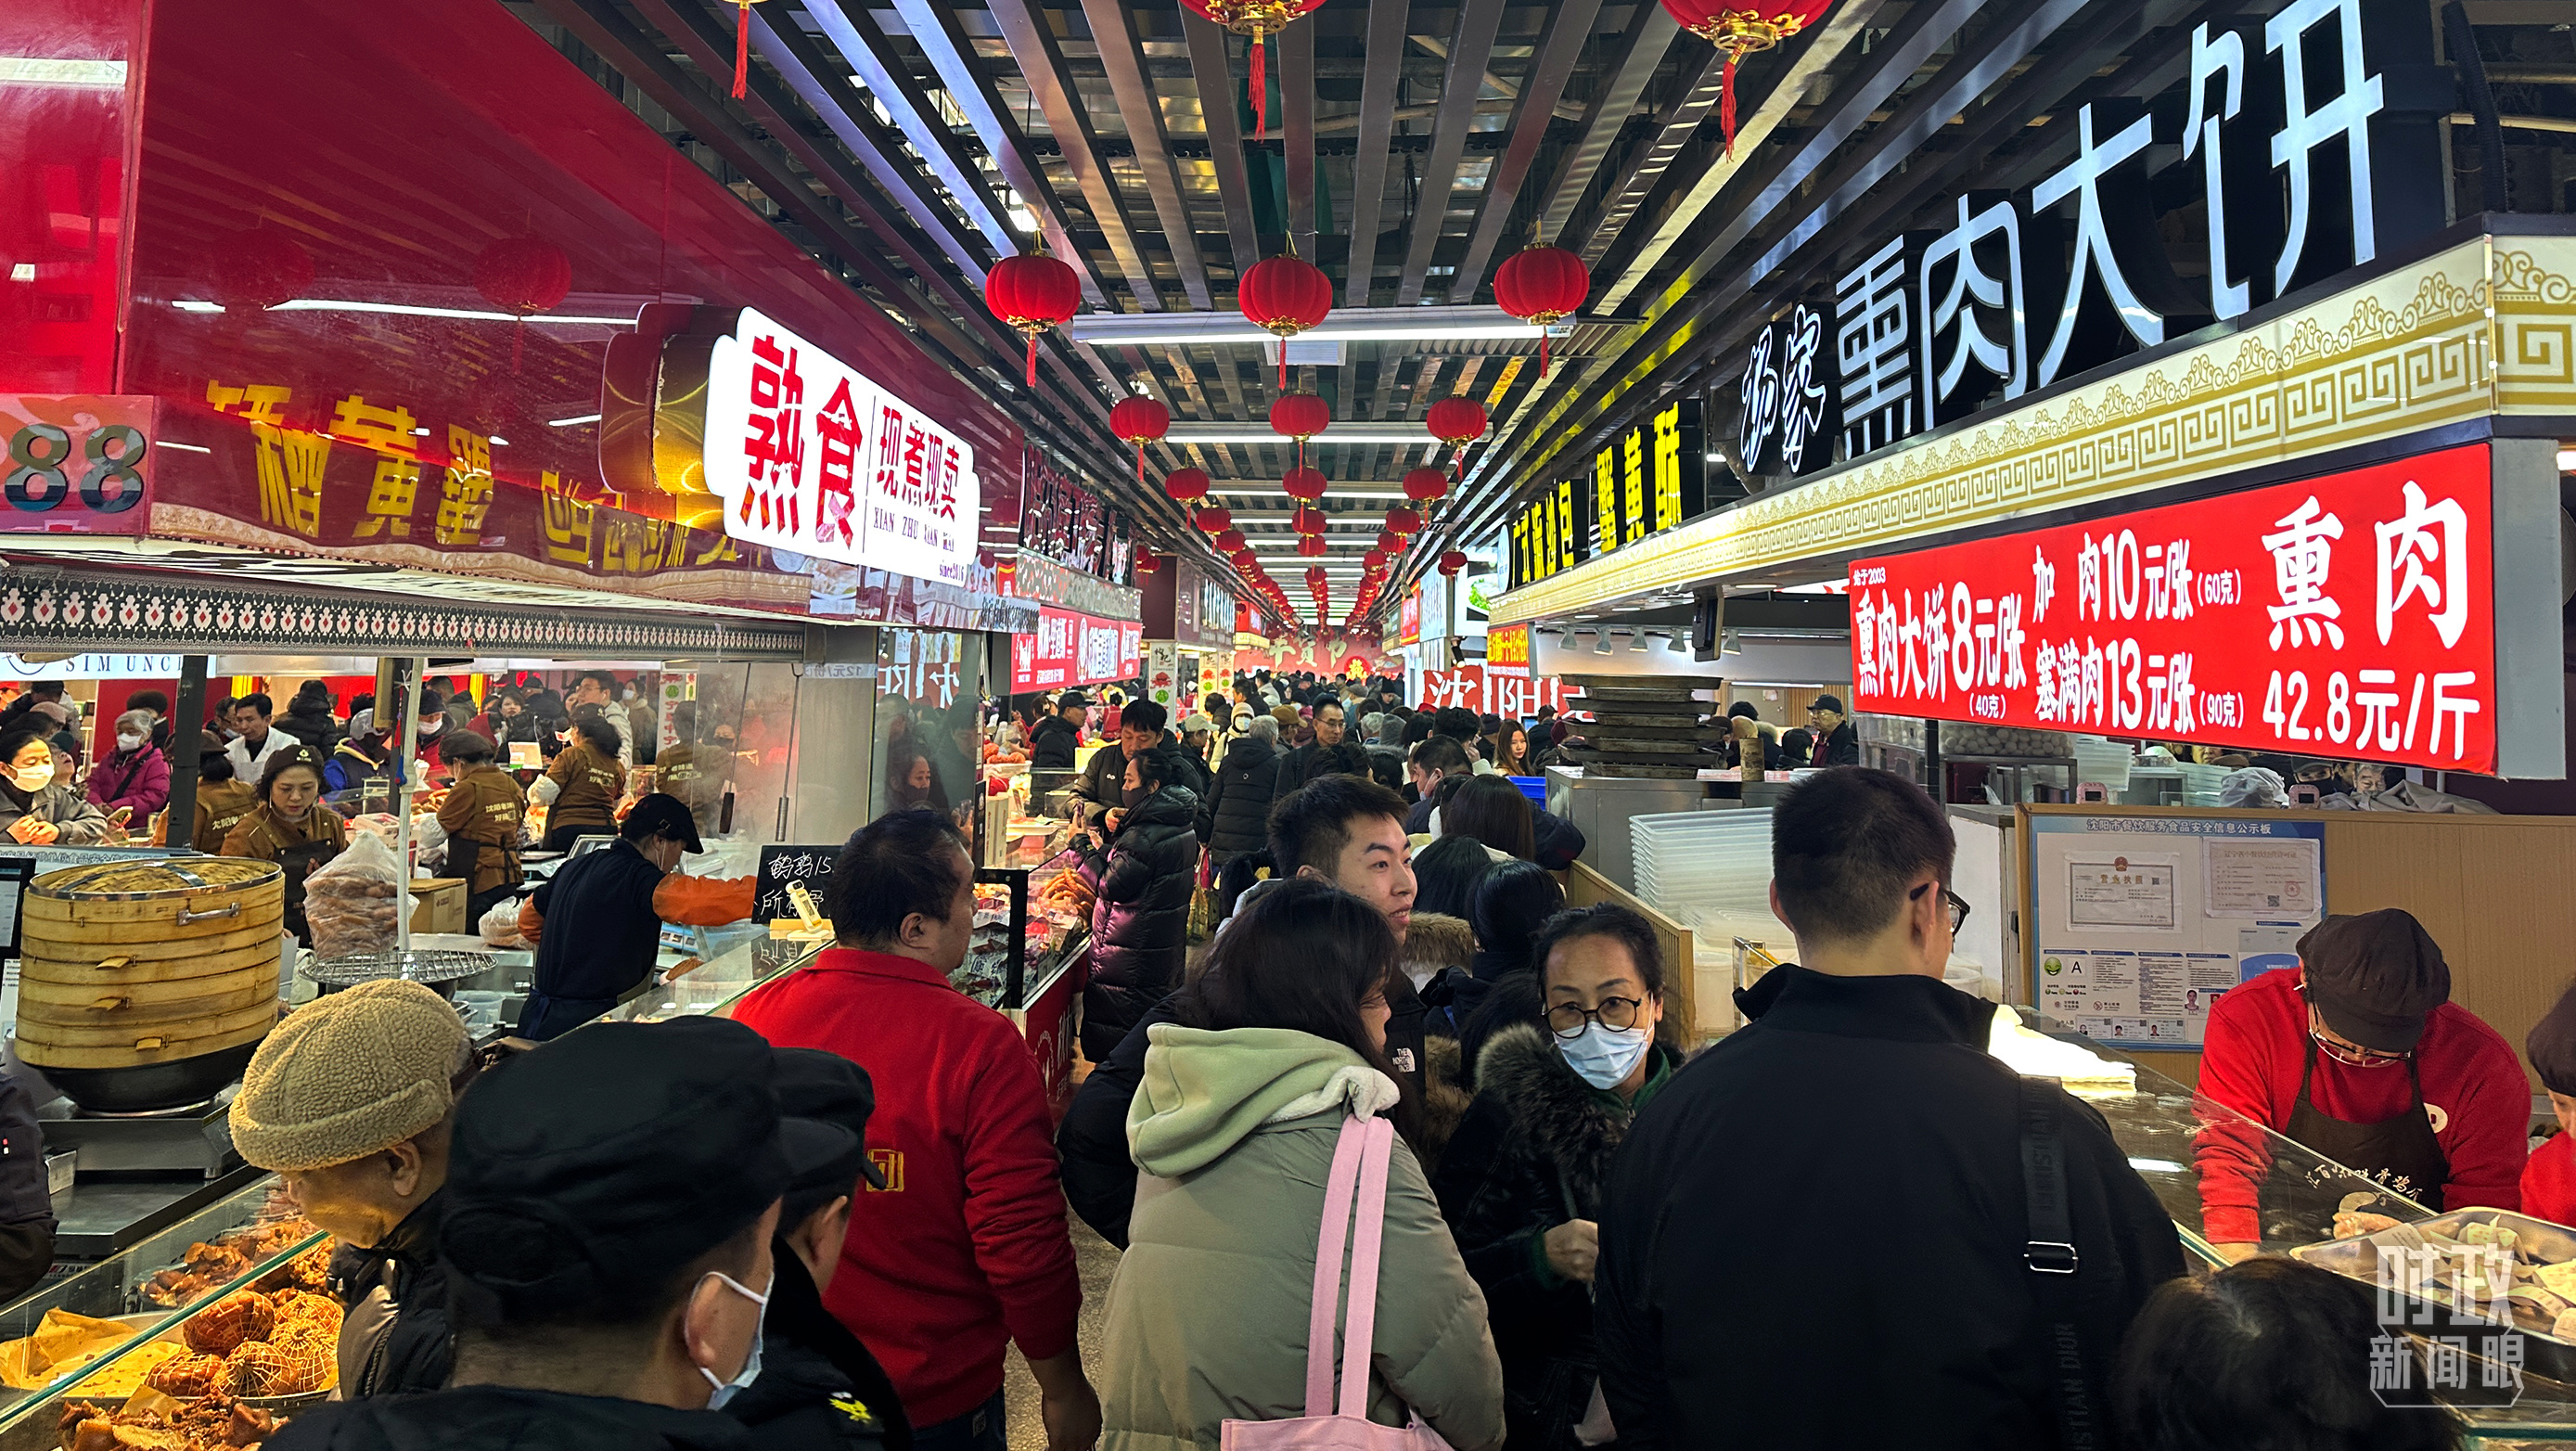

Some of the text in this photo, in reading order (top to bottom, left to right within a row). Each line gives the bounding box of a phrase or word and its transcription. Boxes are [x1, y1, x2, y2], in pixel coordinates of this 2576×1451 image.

[739, 335, 863, 550] 熟食
[877, 405, 960, 522] 现煮现卖
[5, 423, 147, 513] 88
[874, 507, 895, 533] XIAN
[902, 516, 918, 539] ZHU
[924, 524, 938, 546] XIAN
[1853, 567, 1887, 586] 始于2003
[66, 655, 111, 673] SIM
[2262, 669, 2480, 761] 42.8元/斤
[2087, 819, 2272, 835] 沈阳市餐饮服务食品安全信息公示板
[2100, 874, 2144, 885] 营业执照
[2071, 961, 2082, 974] A
